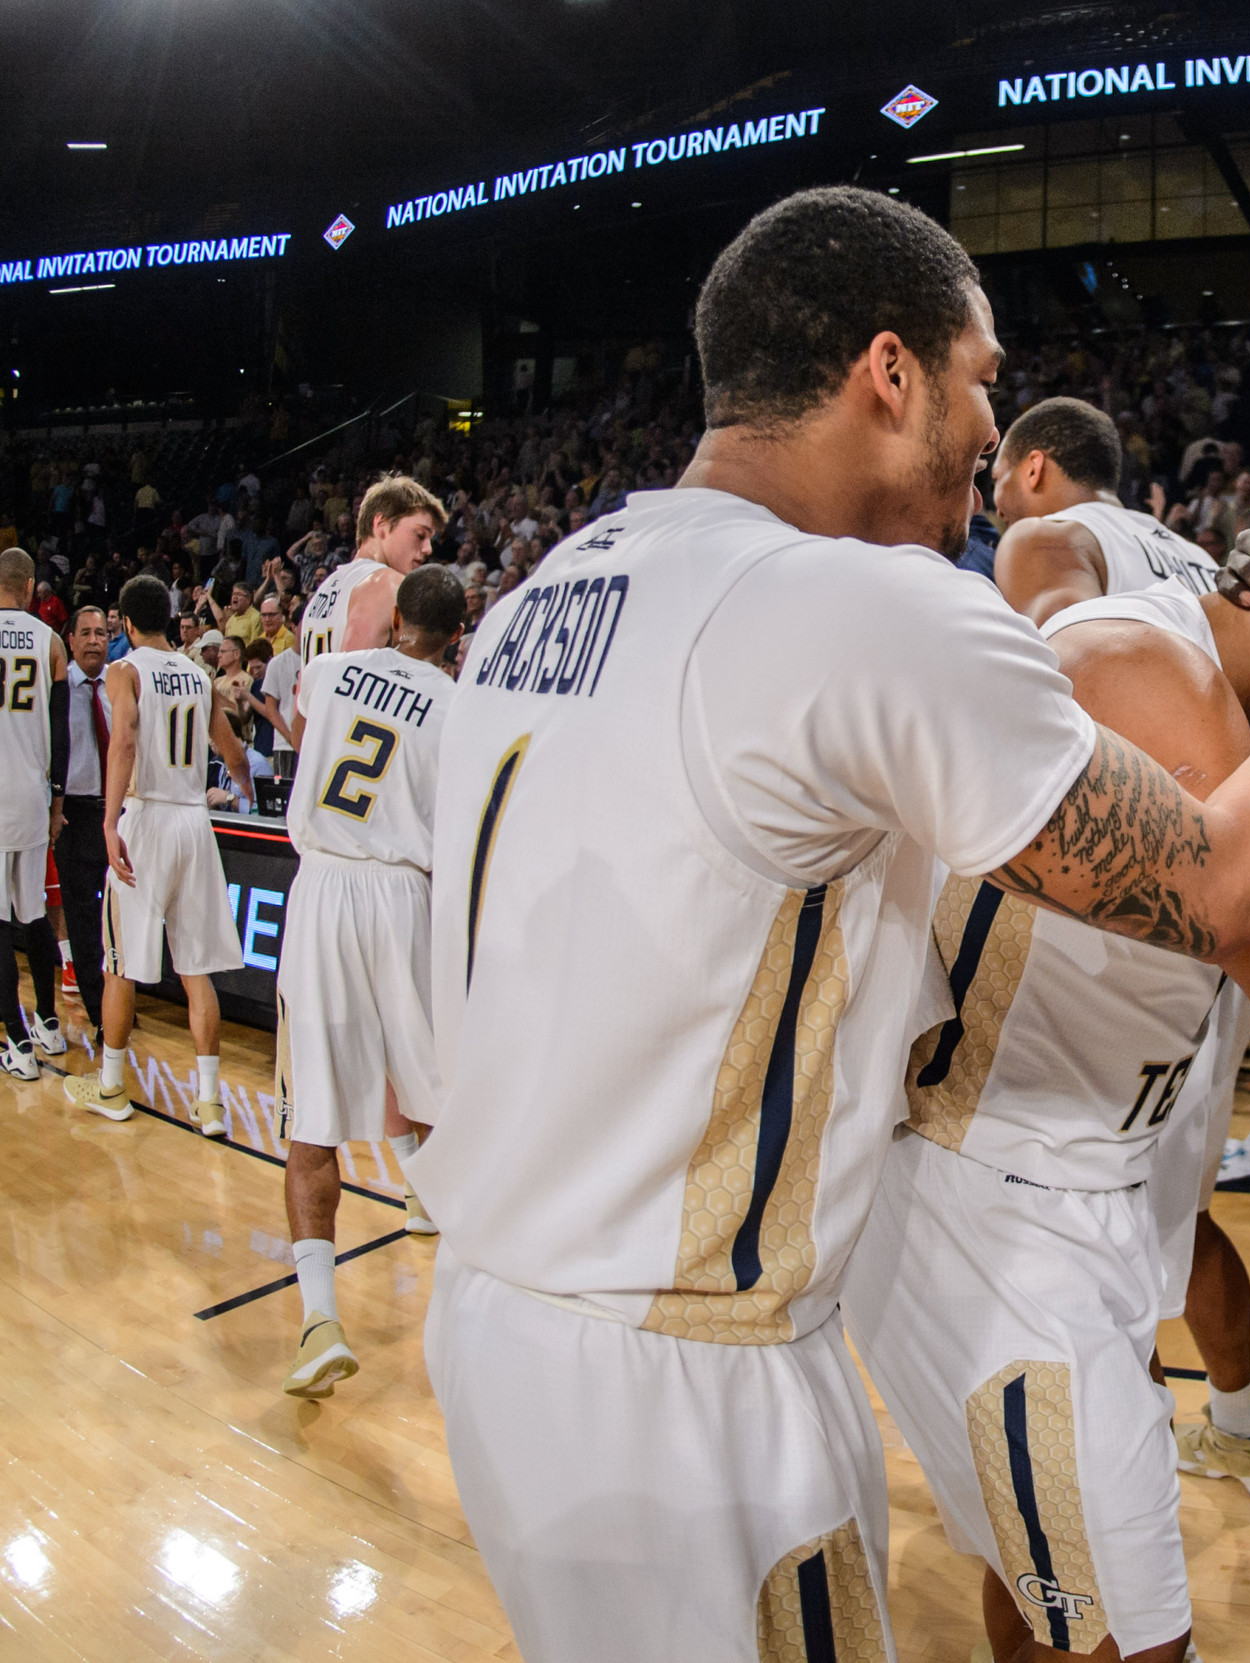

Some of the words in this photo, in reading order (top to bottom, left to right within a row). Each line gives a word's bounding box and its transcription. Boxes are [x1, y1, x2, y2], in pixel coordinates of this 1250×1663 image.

[998, 62, 1176, 107] NATIONAL
[386, 181, 489, 229] NATIONAL
[493, 147, 627, 201] INVITATION
[631, 107, 826, 168] TOURNAMENT
[0, 260, 34, 284] NAL
[37, 247, 143, 279] INVITATION
[146, 234, 292, 267] TOURNAMENT
[1133, 534, 1217, 596] WHIT
[0, 630, 34, 650] COBS
[476, 575, 629, 697] JACKSON
[152, 671, 203, 696] HEATH
[334, 665, 433, 728] SMITH
[168, 703, 197, 768] 11
[317, 715, 400, 823] 2
[466, 732, 532, 1002] 1
[1017, 1573, 1094, 1619] GT
